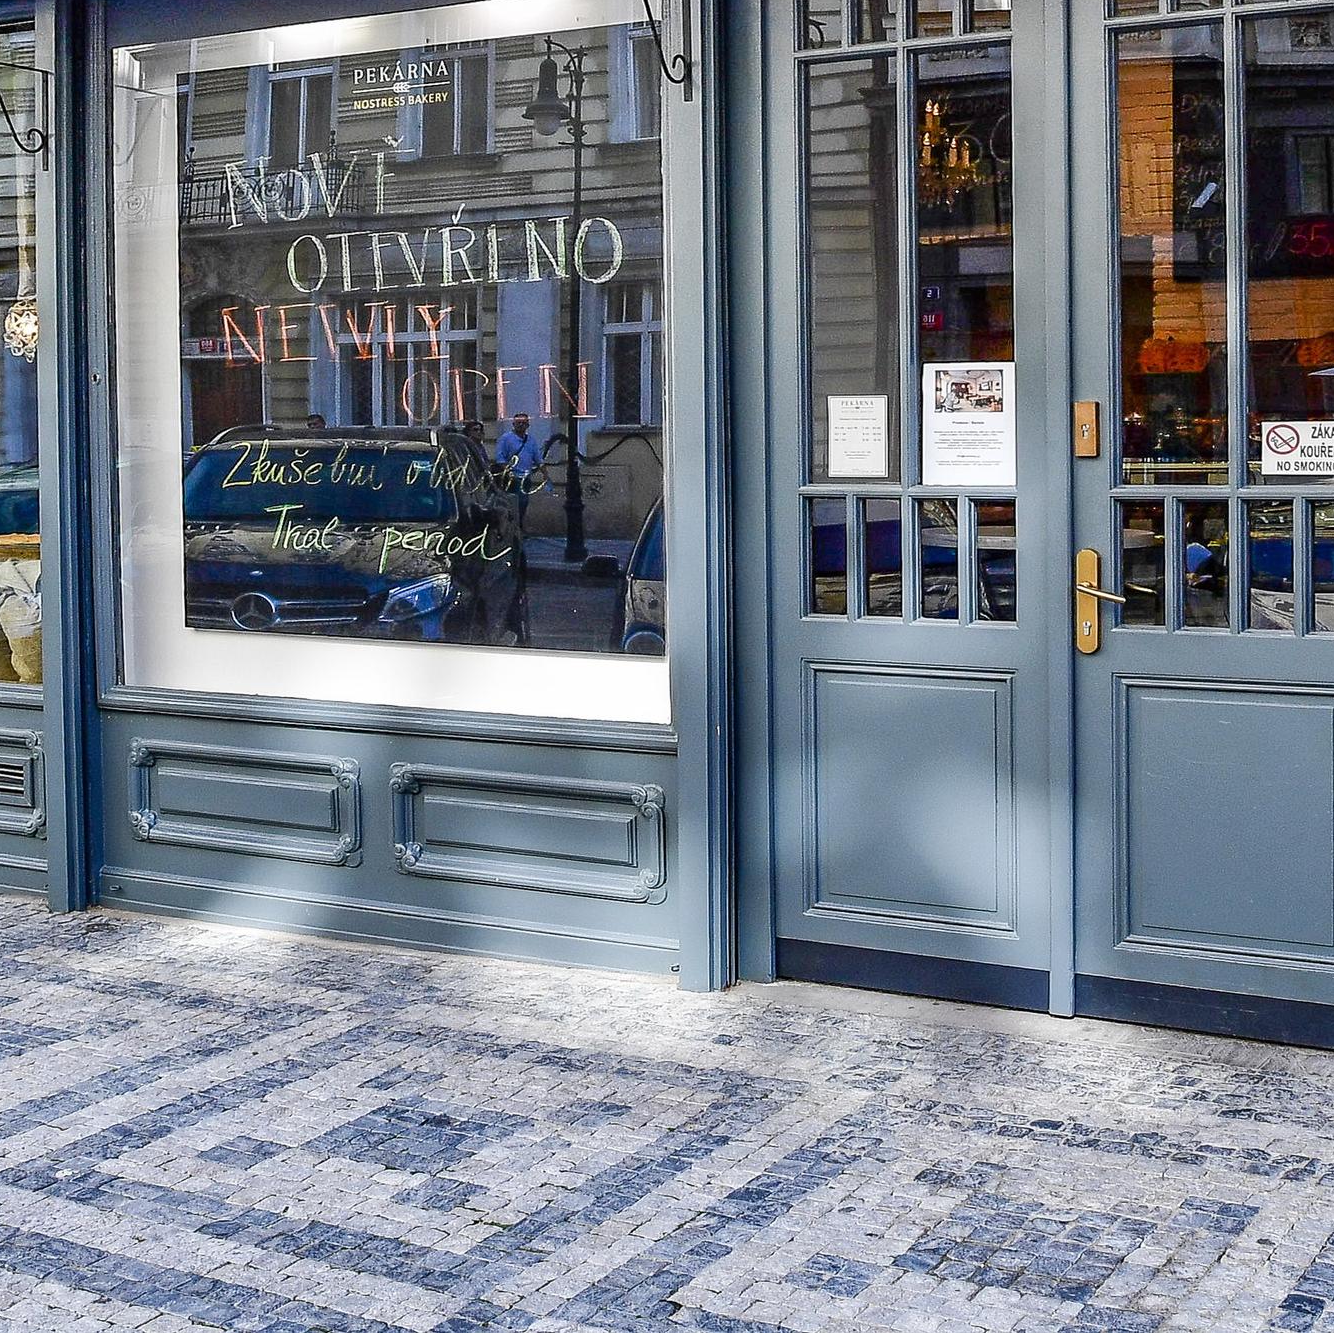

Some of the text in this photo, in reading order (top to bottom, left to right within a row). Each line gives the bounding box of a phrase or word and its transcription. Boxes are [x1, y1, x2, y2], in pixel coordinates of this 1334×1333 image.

[353, 60, 449, 84] PEKÁRNA
[353, 92, 449, 110] NOSTRESS BAKERY
[286, 203, 624, 293] OTEVŘENO
[220, 300, 455, 366] NEWLY
[401, 361, 598, 422] OPEN
[1276, 461, 1291, 472] NO
[264, 504, 339, 550] Trial
